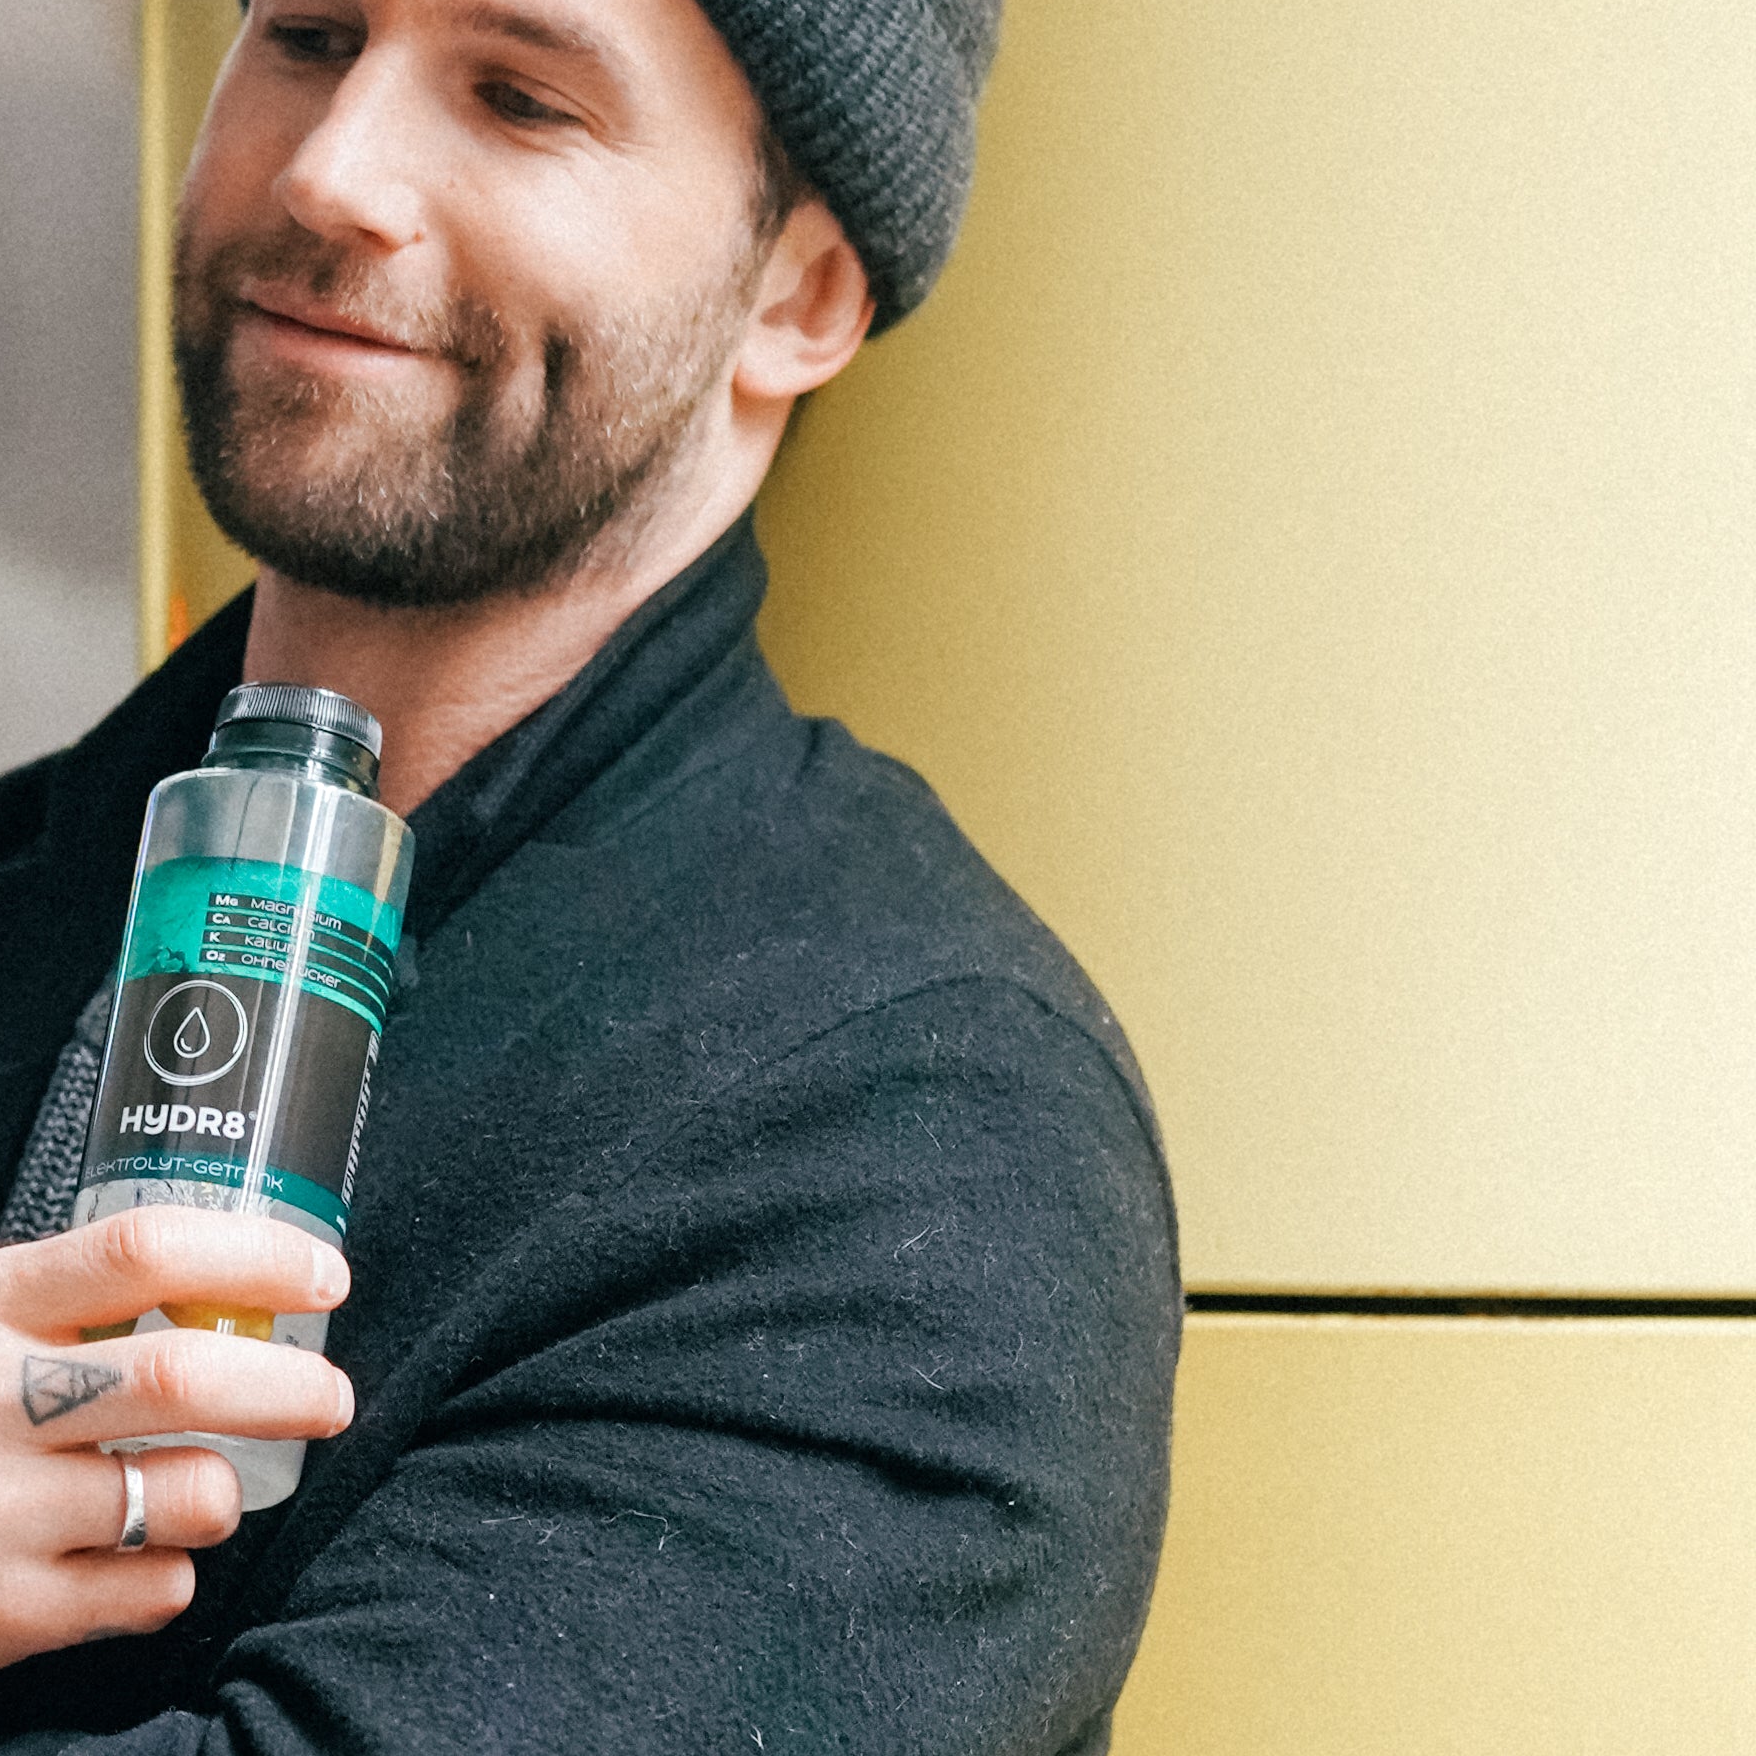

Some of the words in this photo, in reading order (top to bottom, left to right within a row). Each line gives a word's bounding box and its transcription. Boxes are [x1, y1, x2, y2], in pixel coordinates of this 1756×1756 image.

[250, 897, 342, 931] Magnsium
[209, 931, 221, 943] K
[287, 960, 342, 989] ucker
[119, 1103, 246, 1140] HYDR8
